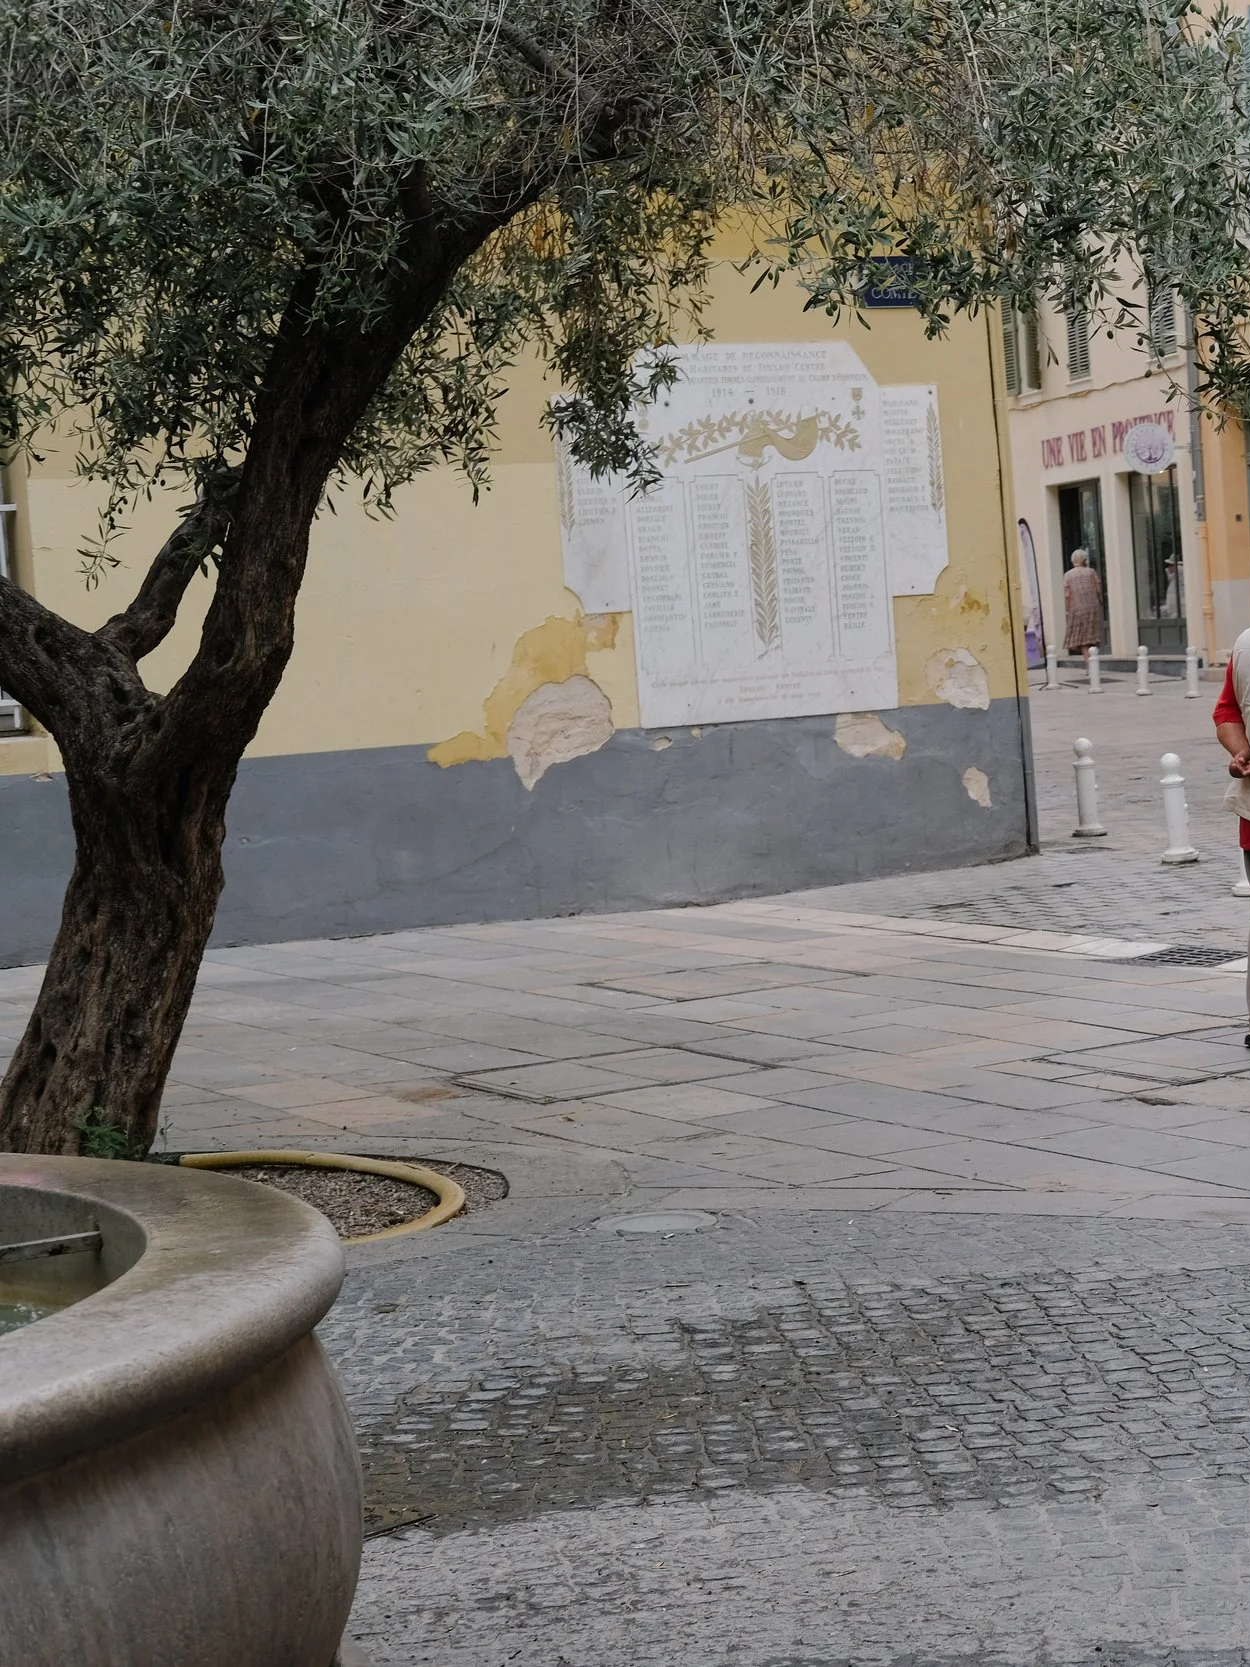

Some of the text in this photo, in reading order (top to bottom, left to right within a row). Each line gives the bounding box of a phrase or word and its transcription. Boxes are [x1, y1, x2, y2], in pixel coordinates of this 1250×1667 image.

[742, 350, 827, 360] RECONNAISSANCE
[712, 387, 733, 398] 1914
[1041, 436, 1064, 469] UNE
[1068, 430, 1087, 463] VIE
[1090, 425, 1107, 459] EN
